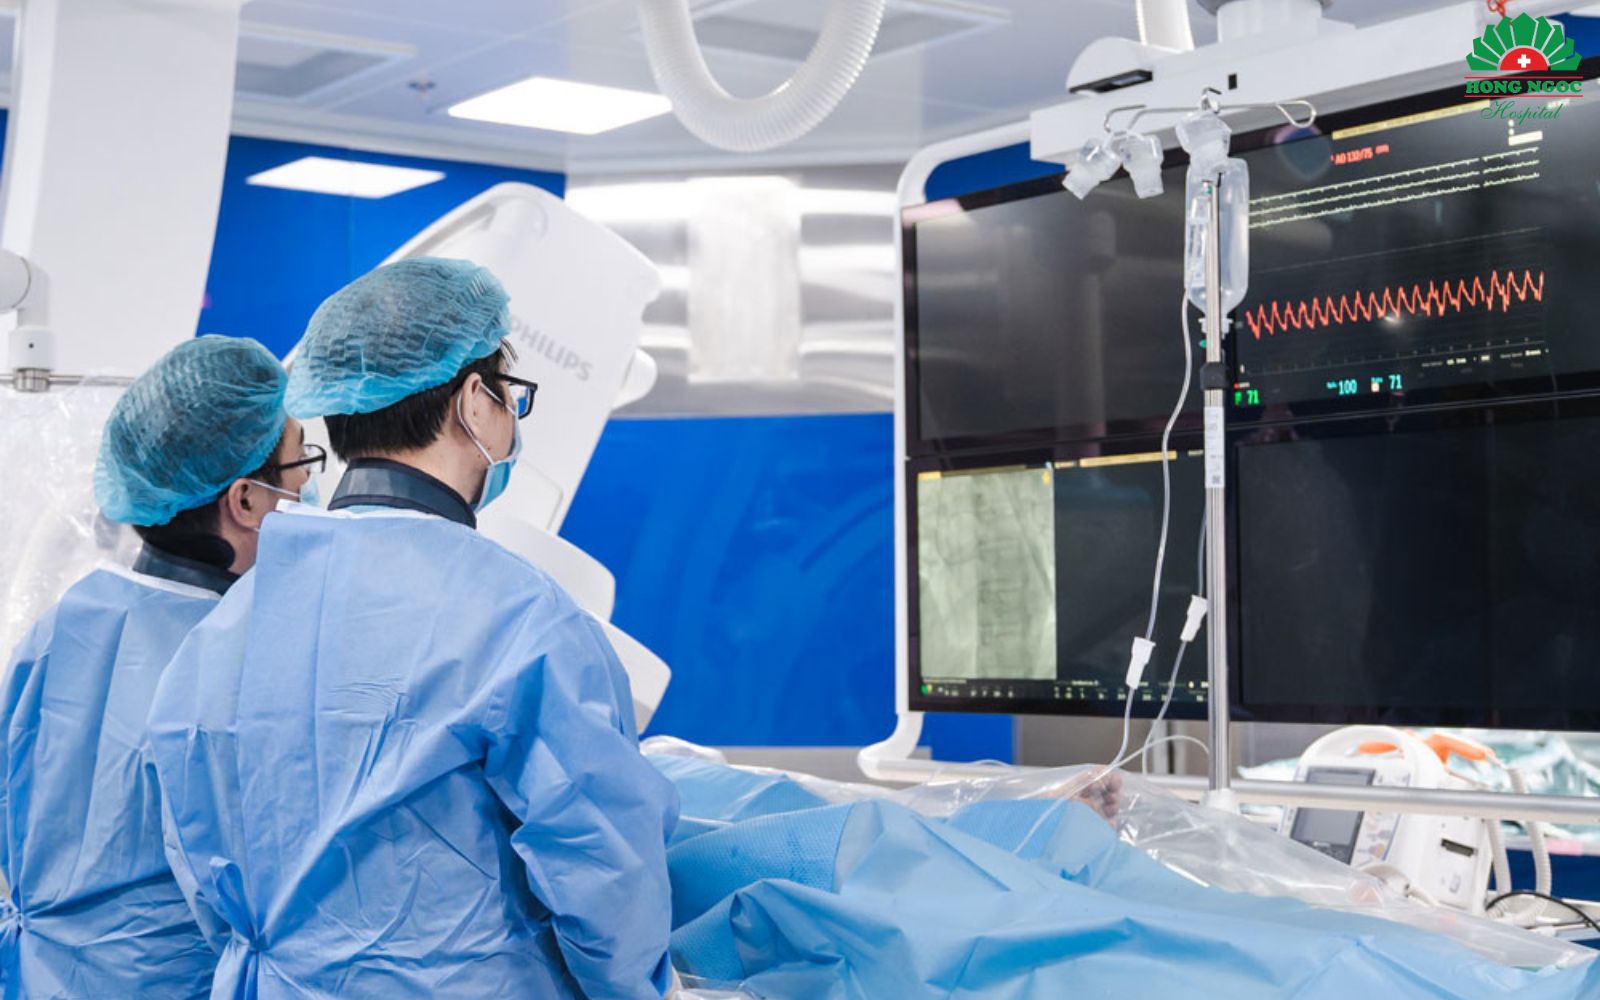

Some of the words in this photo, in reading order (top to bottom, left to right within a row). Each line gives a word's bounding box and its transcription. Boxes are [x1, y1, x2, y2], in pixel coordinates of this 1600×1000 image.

[1338, 379, 1358, 396] 100
[1388, 374, 1403, 390] 71
[1246, 389, 1260, 405] 71
